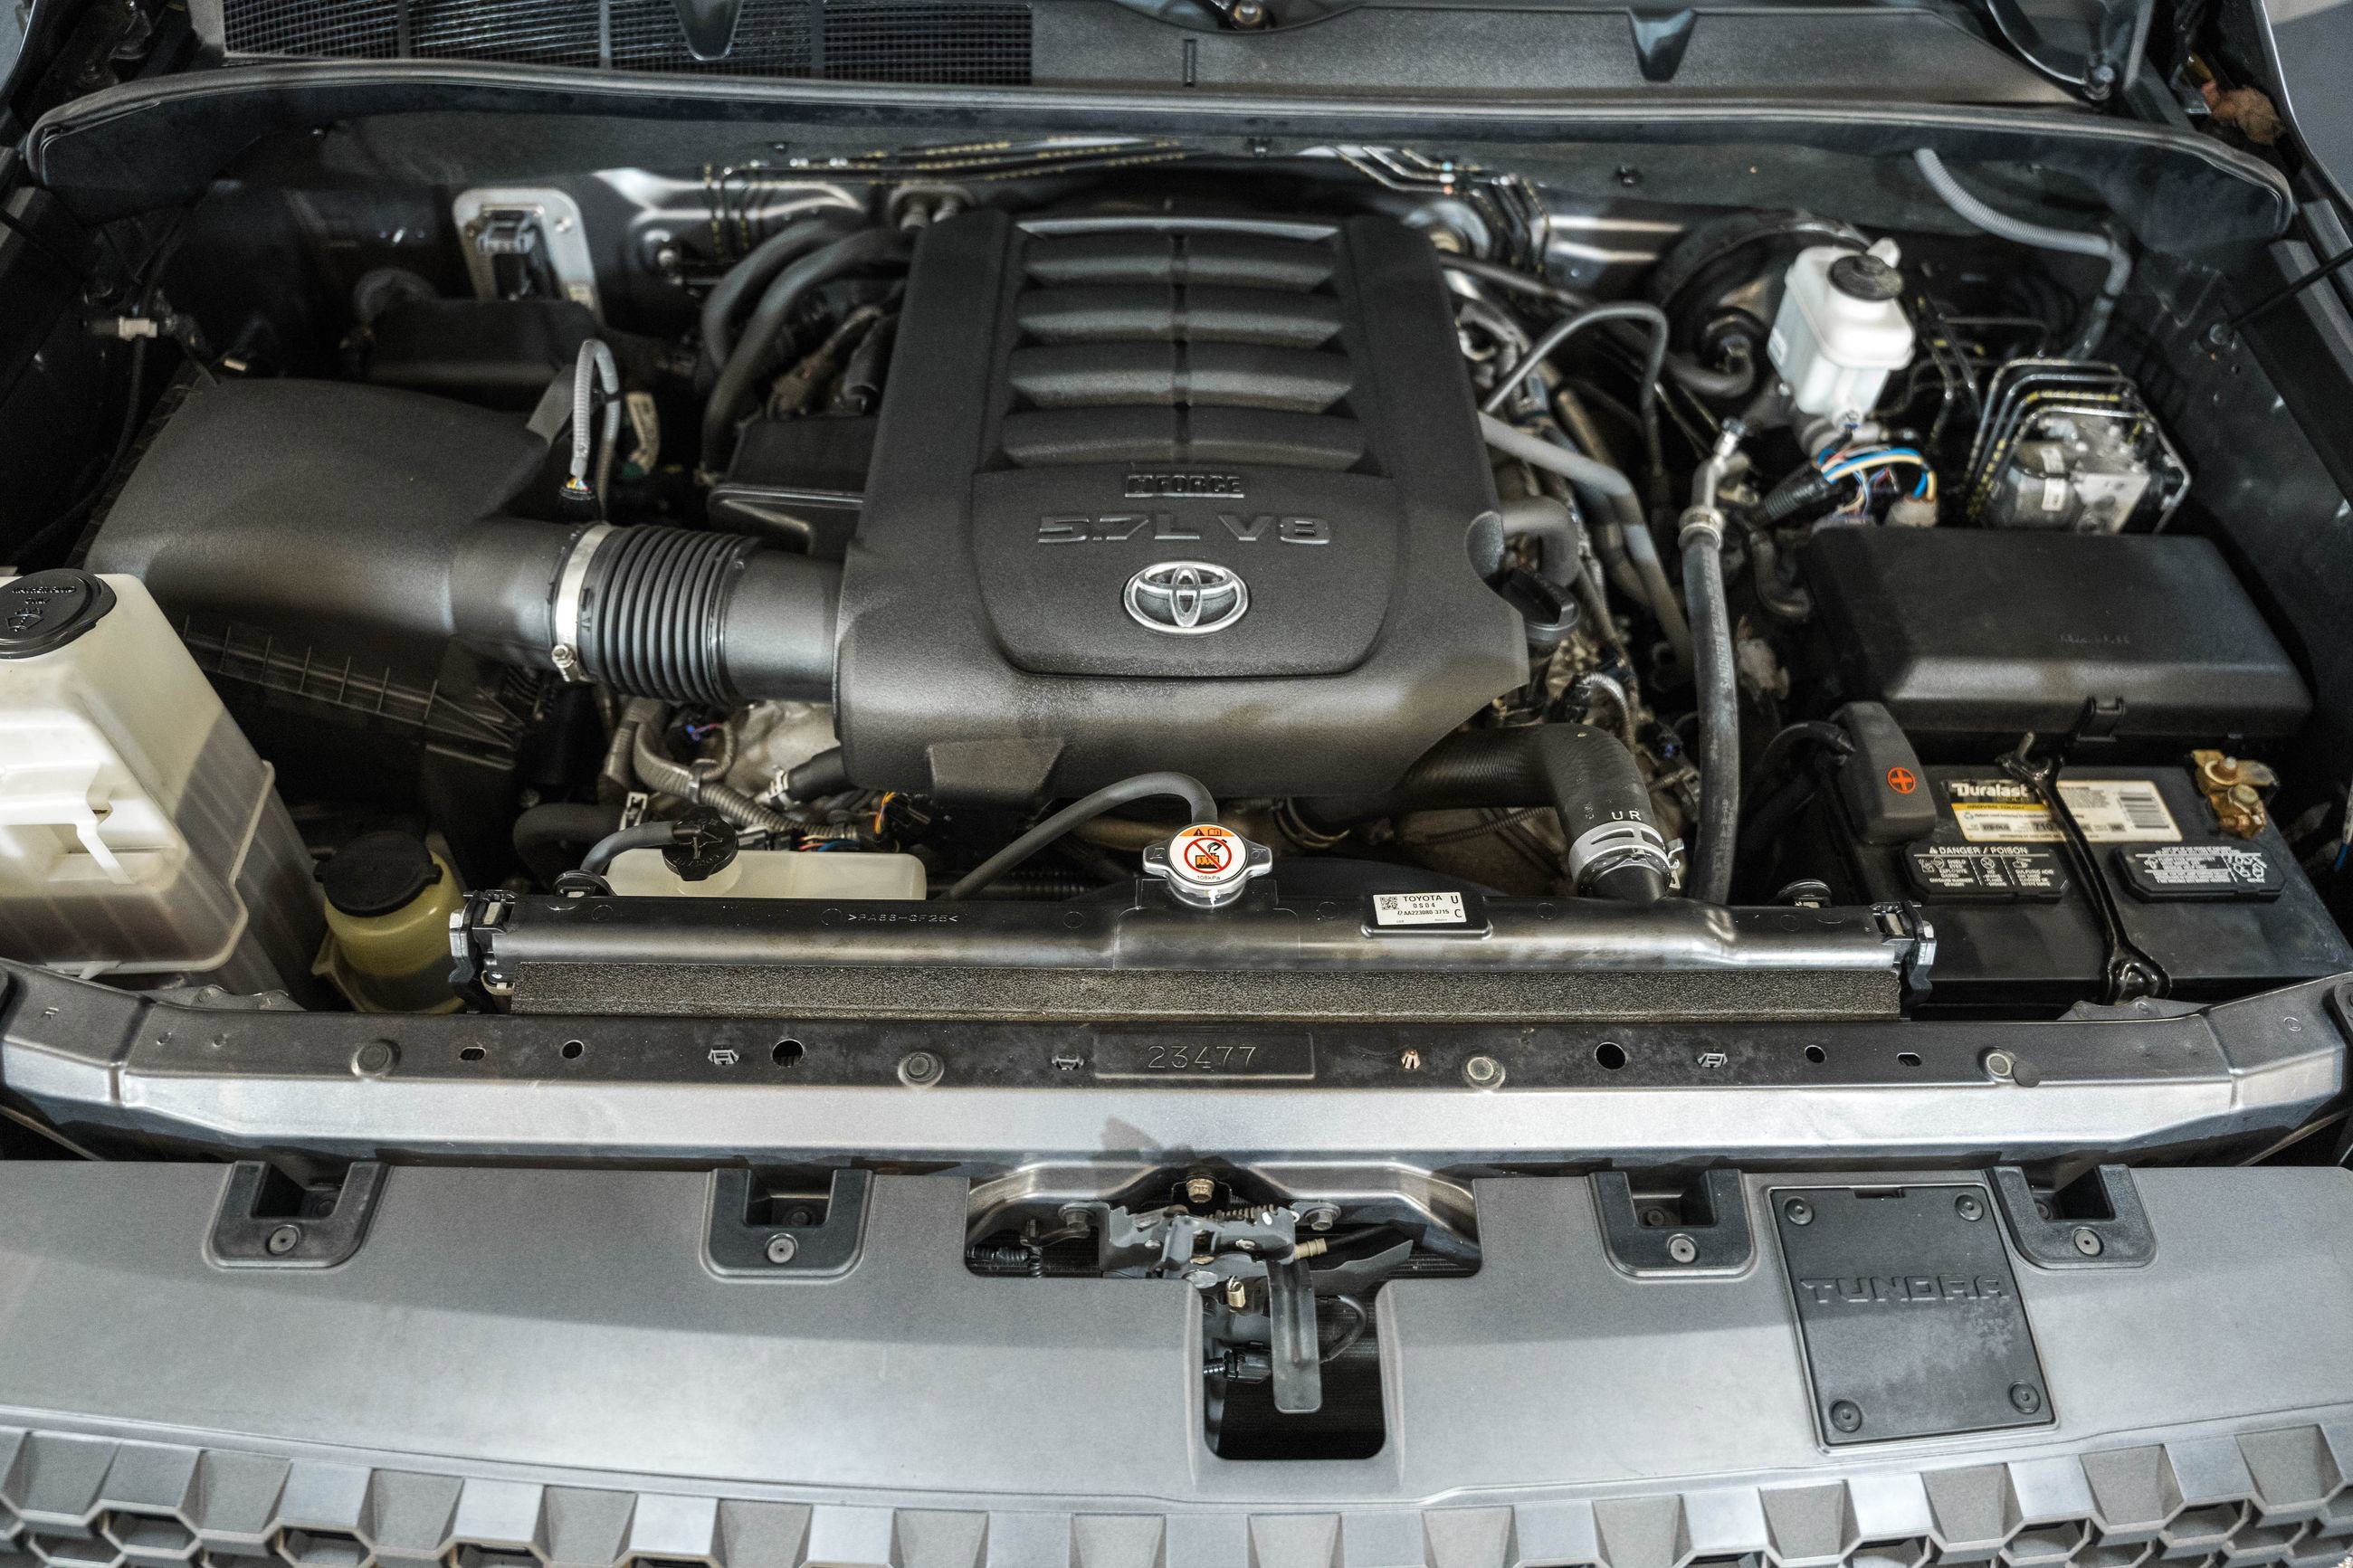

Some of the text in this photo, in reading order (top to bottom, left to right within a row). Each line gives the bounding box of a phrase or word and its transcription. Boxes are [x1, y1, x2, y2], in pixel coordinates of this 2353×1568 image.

[1038, 512, 1331, 545] 5.7L V8
[1951, 783, 2029, 797] Duralast
[1450, 895, 1459, 904] U
[1453, 908, 1462, 918] C
[1148, 1045, 1257, 1069] 23477
[1799, 1273, 2011, 1304] TUNDRA
